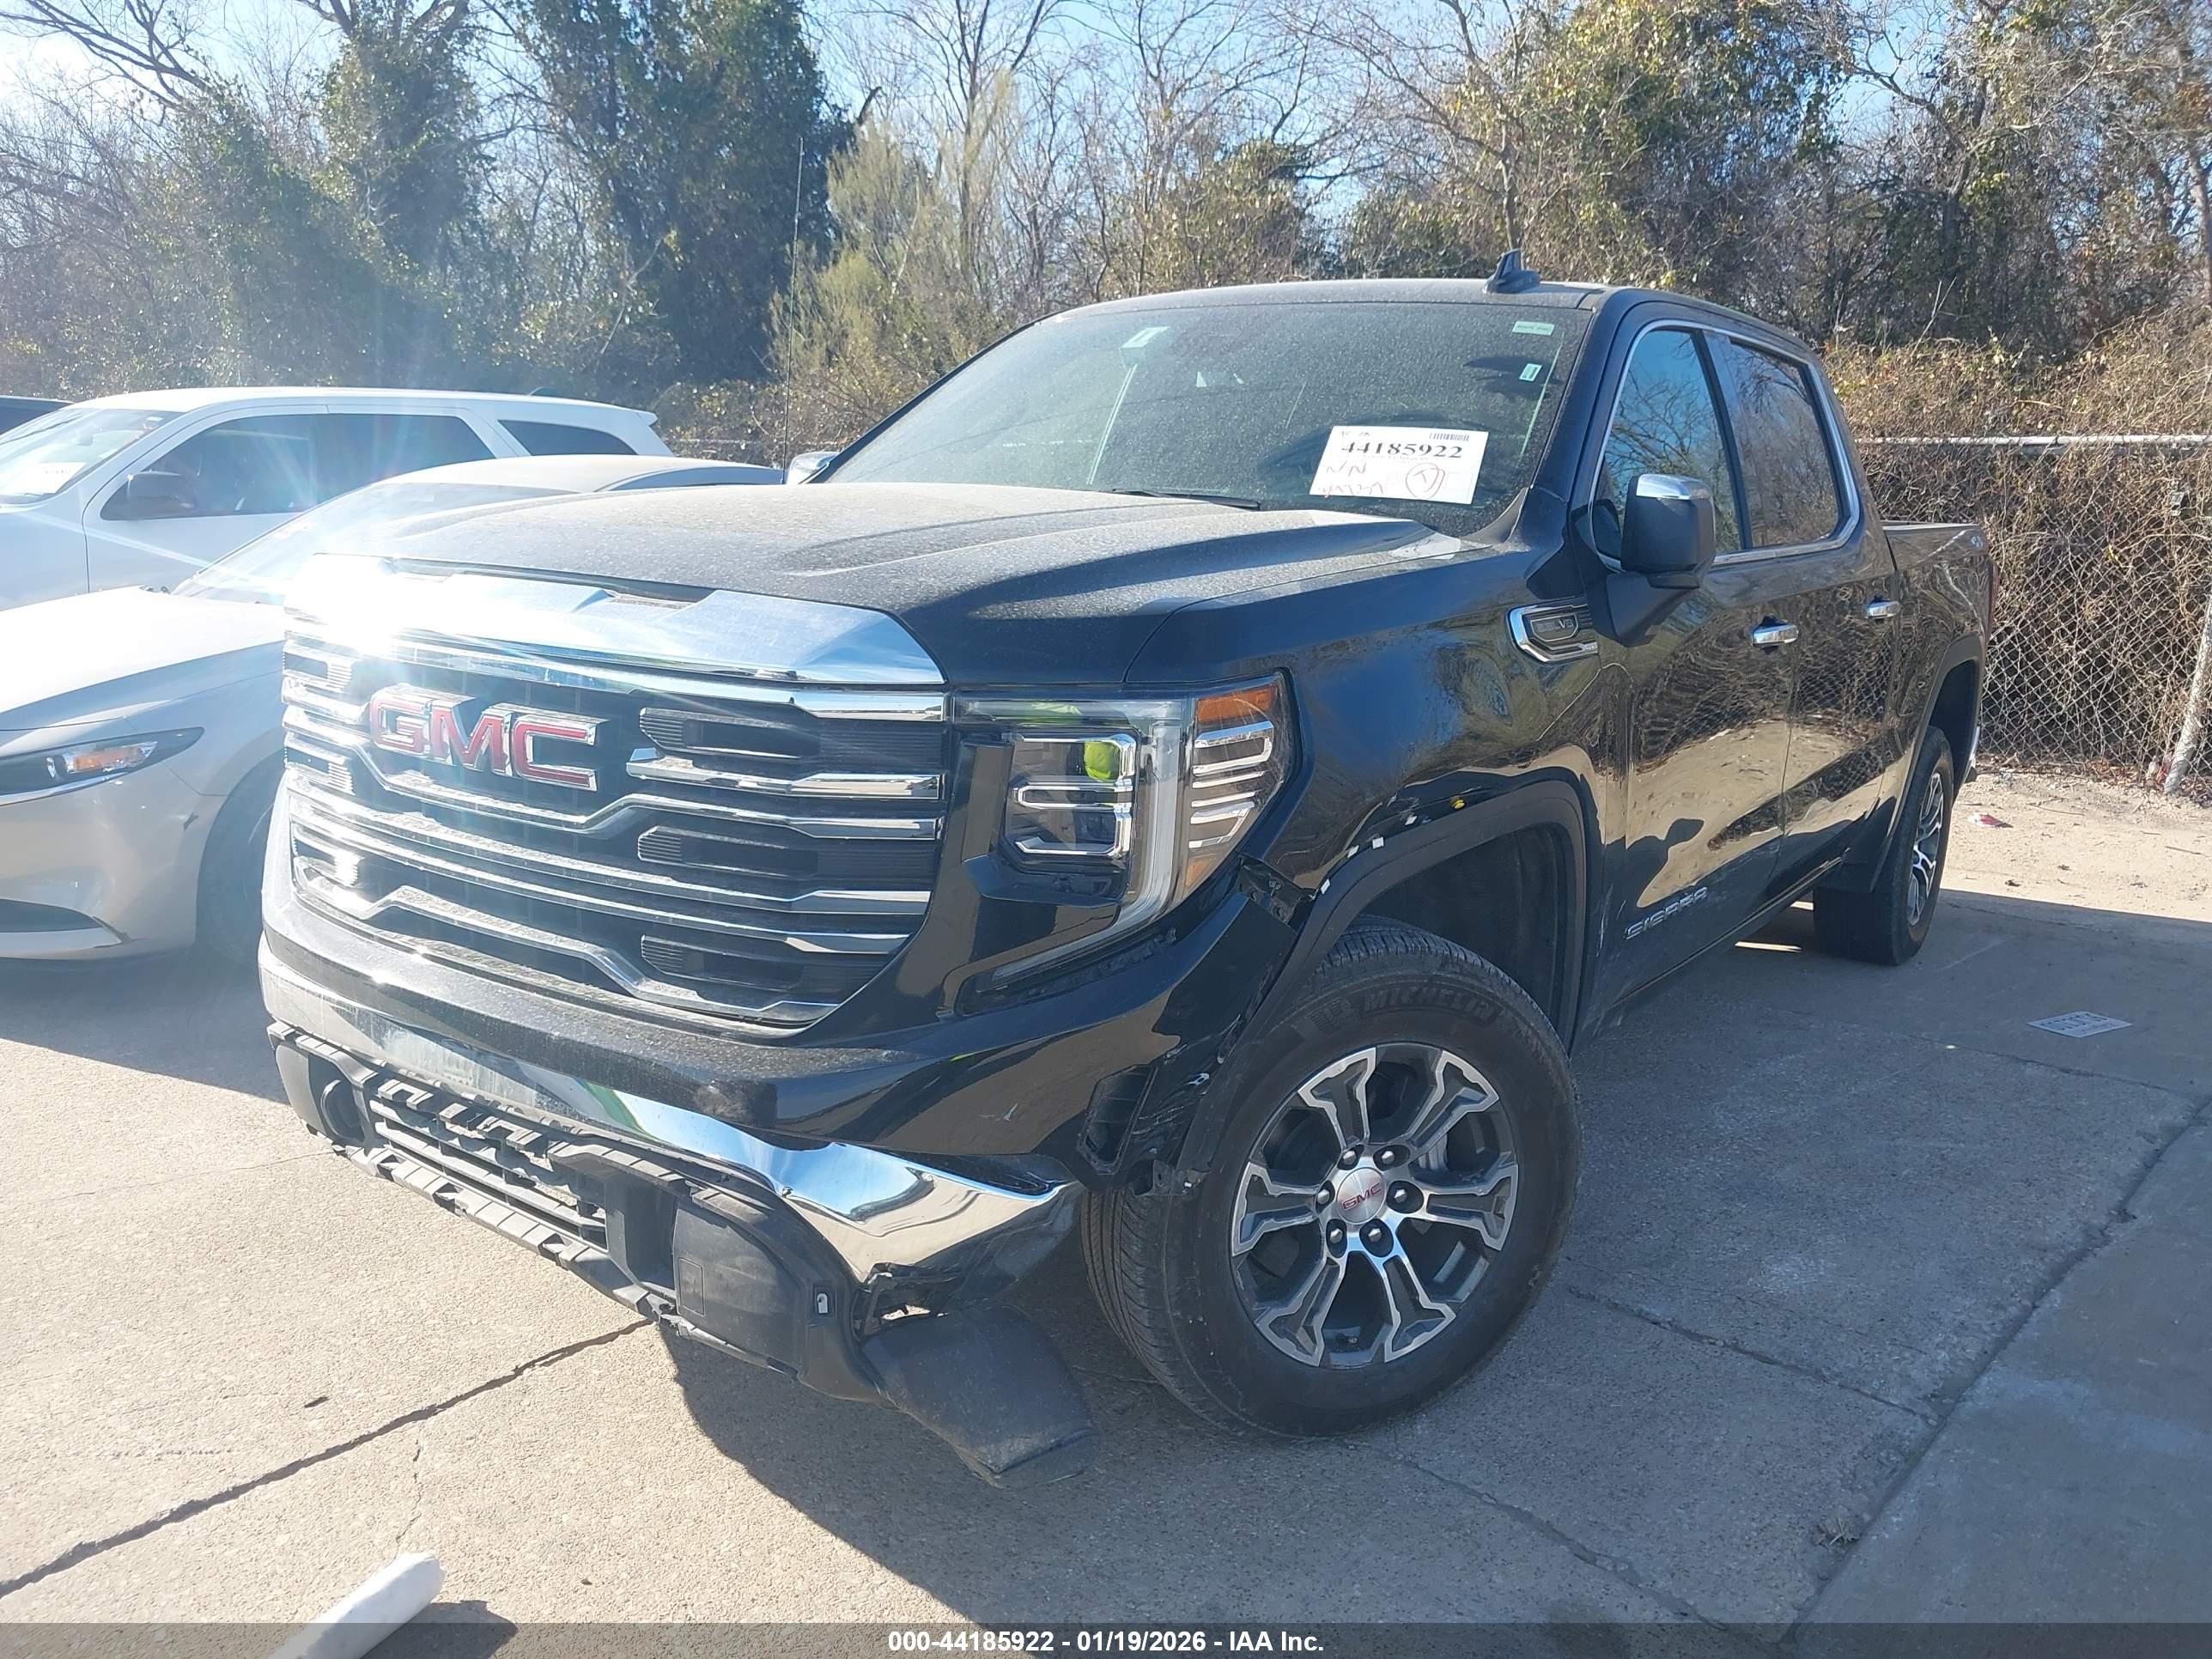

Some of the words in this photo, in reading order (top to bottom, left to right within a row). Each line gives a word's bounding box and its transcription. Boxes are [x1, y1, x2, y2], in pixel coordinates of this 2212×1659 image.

[1340, 441, 1463, 459] 44185922
[369, 684, 600, 793] GMC
[1623, 886, 1709, 940] SIERRA
[1342, 1181, 1382, 1210] GMC
